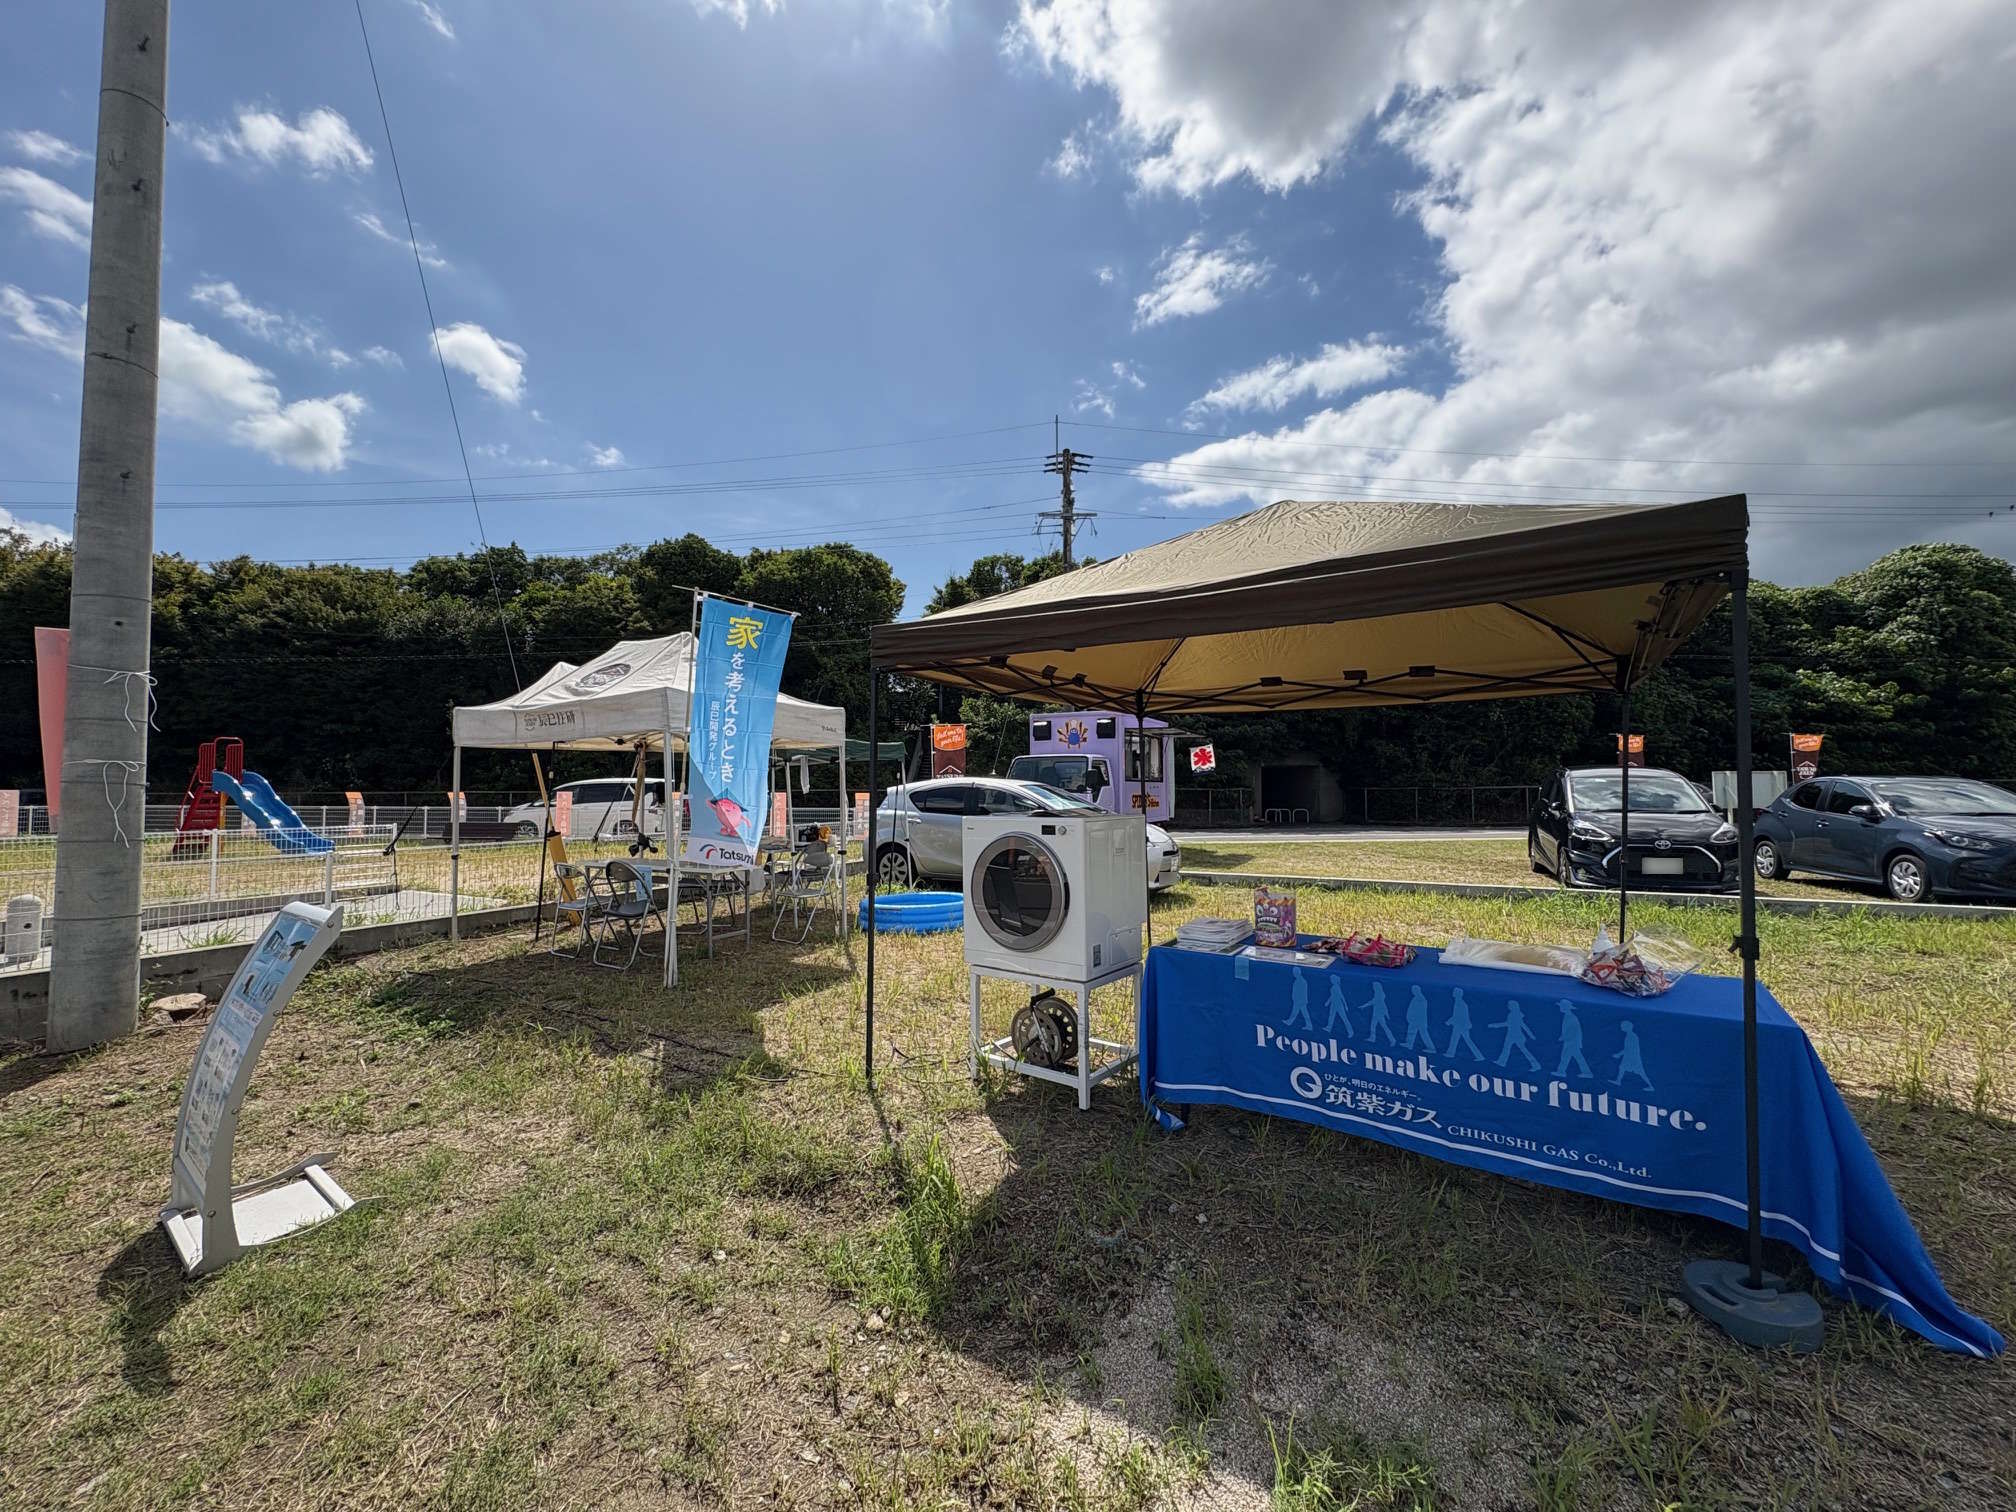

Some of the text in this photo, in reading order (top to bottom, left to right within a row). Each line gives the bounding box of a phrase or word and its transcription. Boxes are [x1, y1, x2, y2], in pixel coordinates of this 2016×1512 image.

[720, 615, 764, 783] 家を考えるとき
[719, 848, 754, 866] Tatsumi
[1255, 1024, 1708, 1132] People make our future.
[1325, 1085, 1443, 1129] 筑紫ガス
[1448, 1125, 1653, 1179] CHIKUSHI GAS Co.,Ltd.
